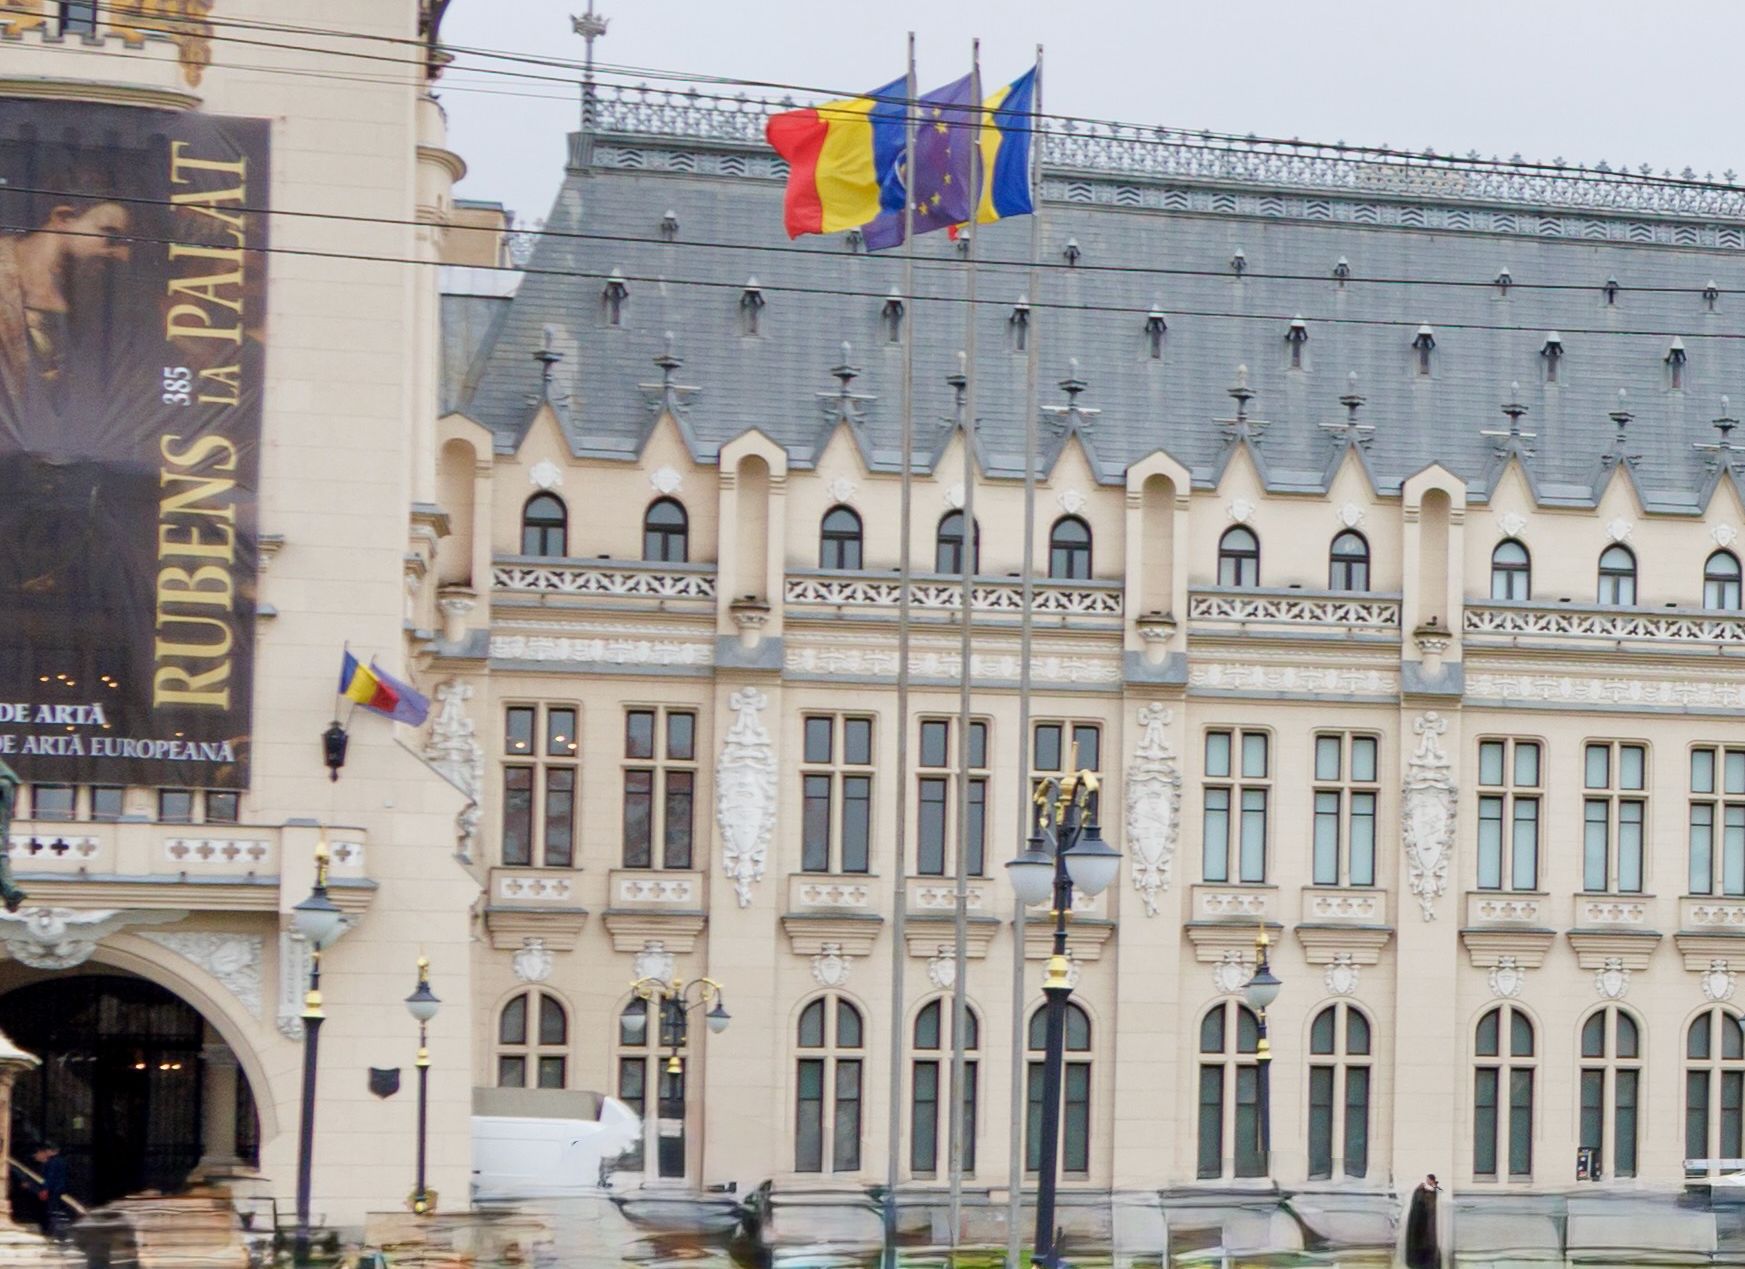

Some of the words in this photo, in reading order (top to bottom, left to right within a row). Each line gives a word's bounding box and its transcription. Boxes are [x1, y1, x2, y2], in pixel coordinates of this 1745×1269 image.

[166, 140, 248, 347] PALAT
[162, 364, 193, 408] 385
[198, 363, 242, 407] LA
[153, 433, 239, 712] RUBENS
[35, 702, 108, 725] ARTĂ
[22, 733, 85, 756] ARTĂ
[89, 737, 236, 763] EUROPEANĂ
